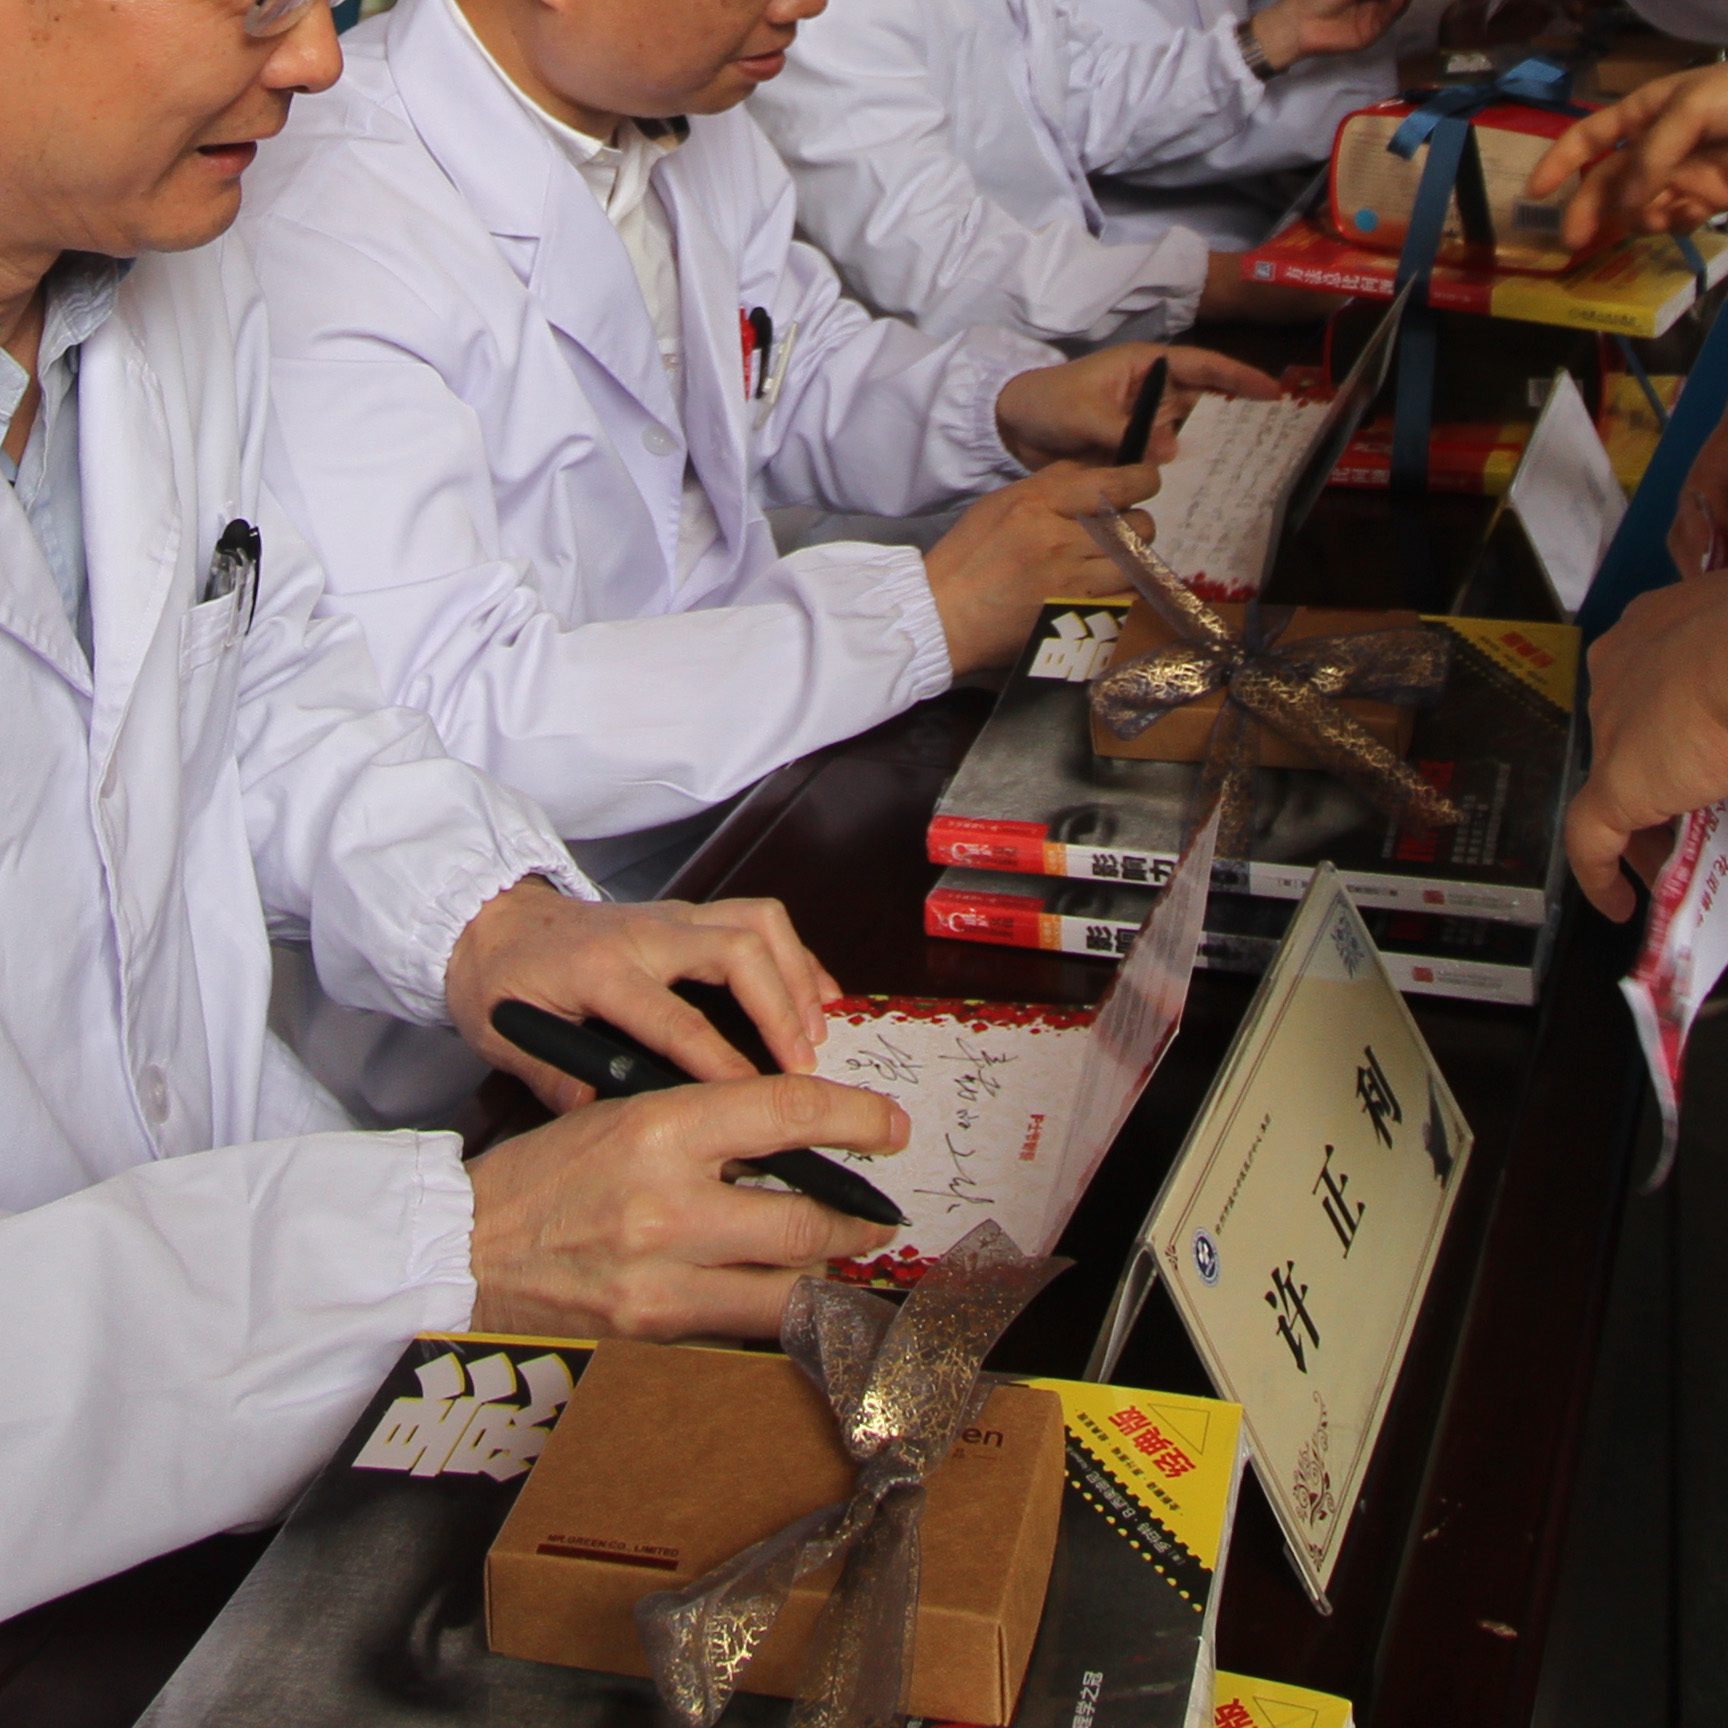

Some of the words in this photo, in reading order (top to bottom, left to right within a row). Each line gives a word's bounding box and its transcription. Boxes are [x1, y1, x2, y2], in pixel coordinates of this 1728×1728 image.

[1264, 1045, 1403, 1374] 许正利
[1109, 1406, 1197, 1479] 经典版
